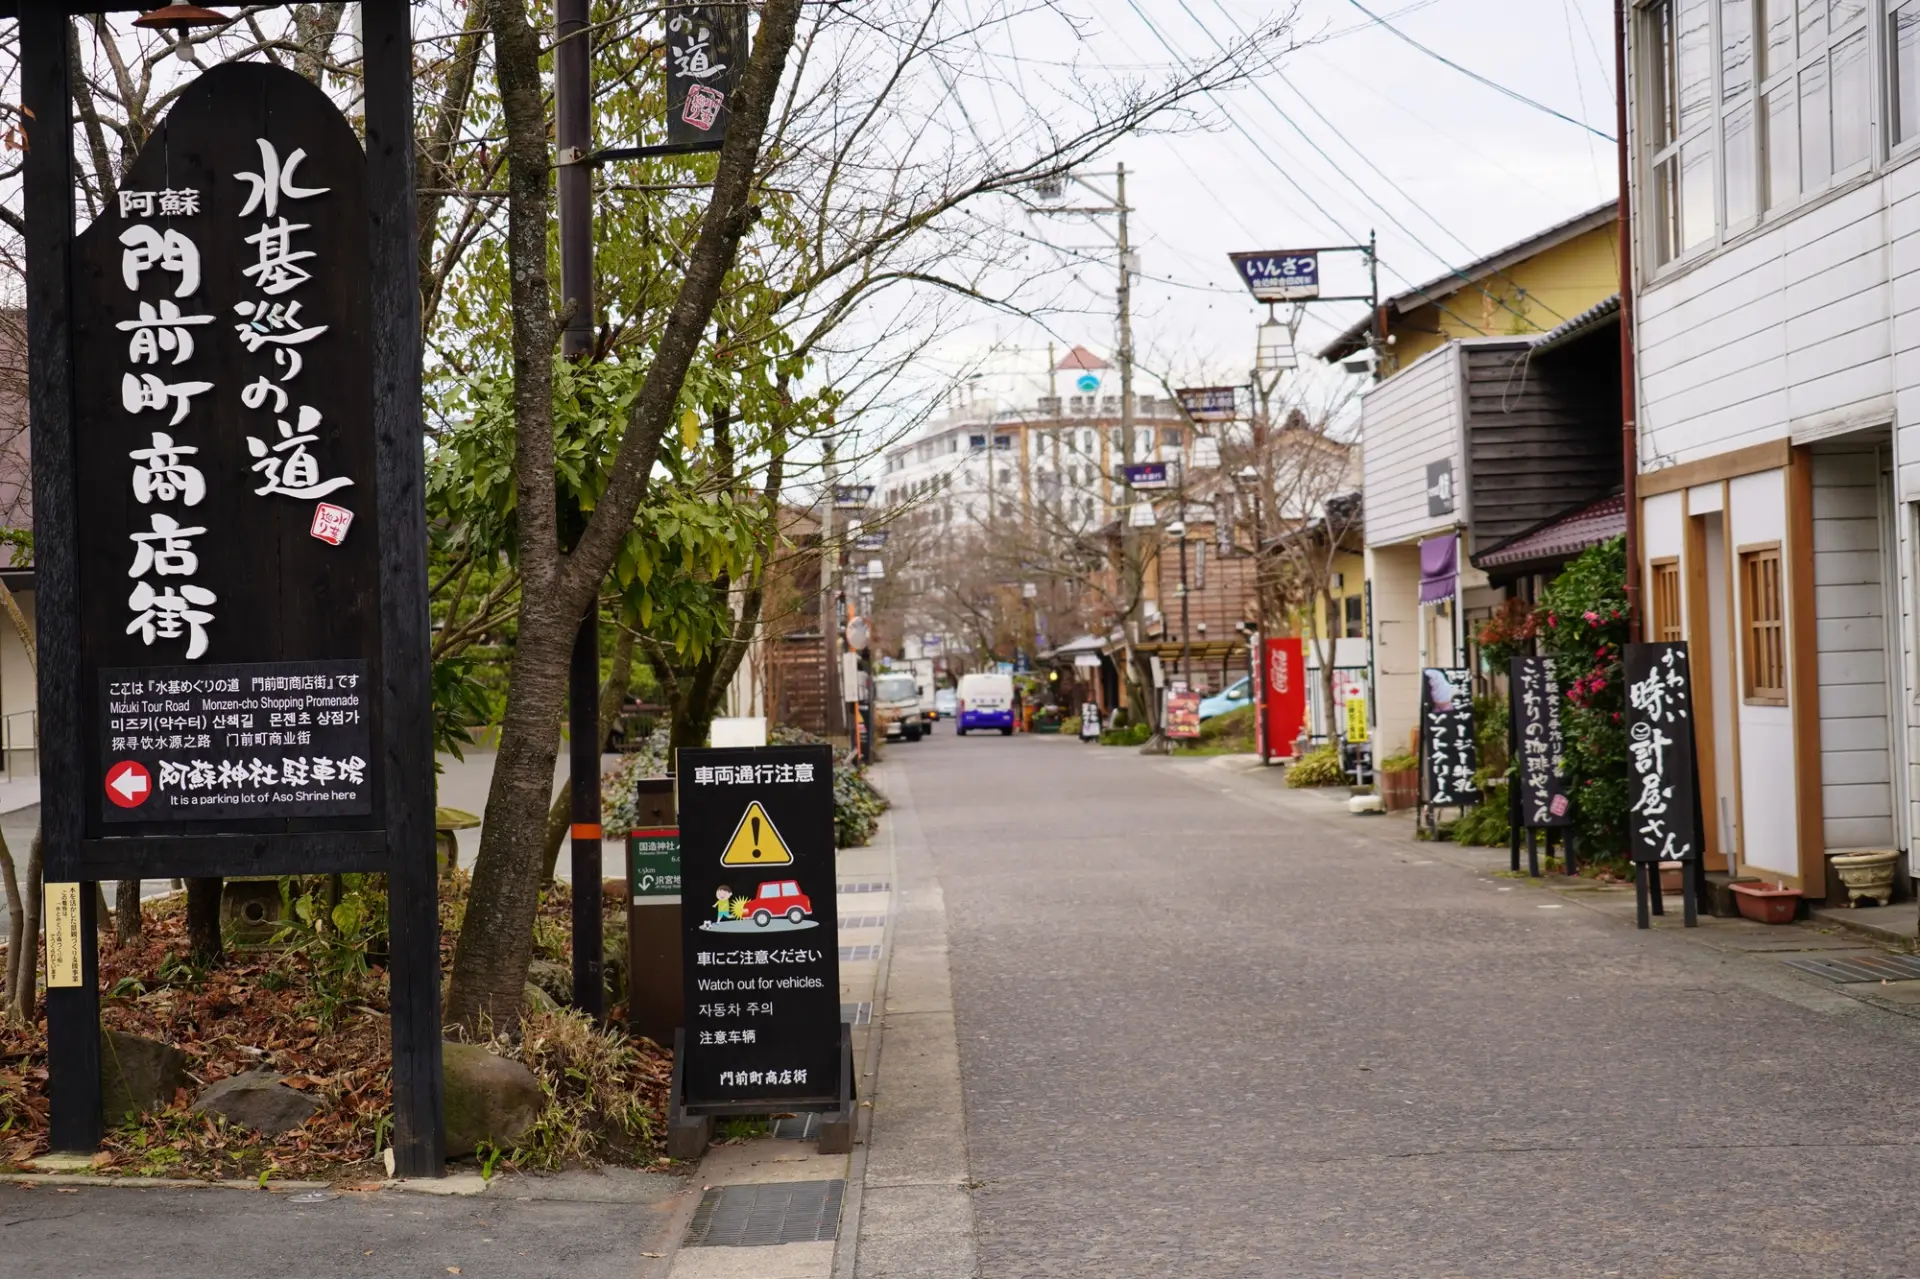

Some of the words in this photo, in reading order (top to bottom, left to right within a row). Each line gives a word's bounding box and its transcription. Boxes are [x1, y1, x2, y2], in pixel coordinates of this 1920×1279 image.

[118, 189, 200, 218] 阿蘇
[1247, 258, 1316, 276] いんさつ
[233, 138, 354, 499] 水基巡りの道
[116, 224, 216, 659] 門前町商店街
[110, 678, 240, 696] ここは『水基めぐりの道
[252, 674, 359, 692] 門前町商店街』です
[1661, 648, 1687, 723] かわいい
[110, 701, 139, 713] Mizuki
[142, 701, 163, 712] Tour
[166, 700, 190, 711] Road
[203, 698, 258, 710] Monzen-cho
[261, 697, 304, 710] Shopping
[306, 694, 359, 706] Promenade
[111, 715, 206, 731] 미즈키(약수터)
[213, 714, 253, 729] 산책길
[270, 712, 311, 727] 몬젠초
[317, 710, 360, 725] 상점가
[112, 734, 211, 750] 探寻饮水源之路
[227, 731, 311, 747] 门前町商业街
[1428, 713, 1453, 803] ソフトクリーム
[1629, 666, 1691, 860] 時計屋さん
[159, 757, 366, 791] 阿蘇神社駐車場
[695, 763, 814, 785] 車両通行注意
[171, 796, 179, 805] It
[181, 796, 190, 804] is
[200, 793, 239, 806] parking
[242, 793, 255, 802] lot
[257, 792, 270, 802] of
[272, 792, 294, 801] Aso
[296, 790, 329, 801] Shrine
[331, 790, 356, 800] here
[697, 949, 822, 965] 車にご注意ください
[698, 979, 734, 990] Watch
[737, 979, 755, 989] out
[758, 978, 773, 988] for
[776, 976, 824, 988] vehicles.
[699, 1003, 740, 1016] 자동차
[747, 1002, 773, 1015] 주의
[700, 1030, 756, 1044] 注意车辆
[720, 1069, 807, 1085] 門前町商店街
